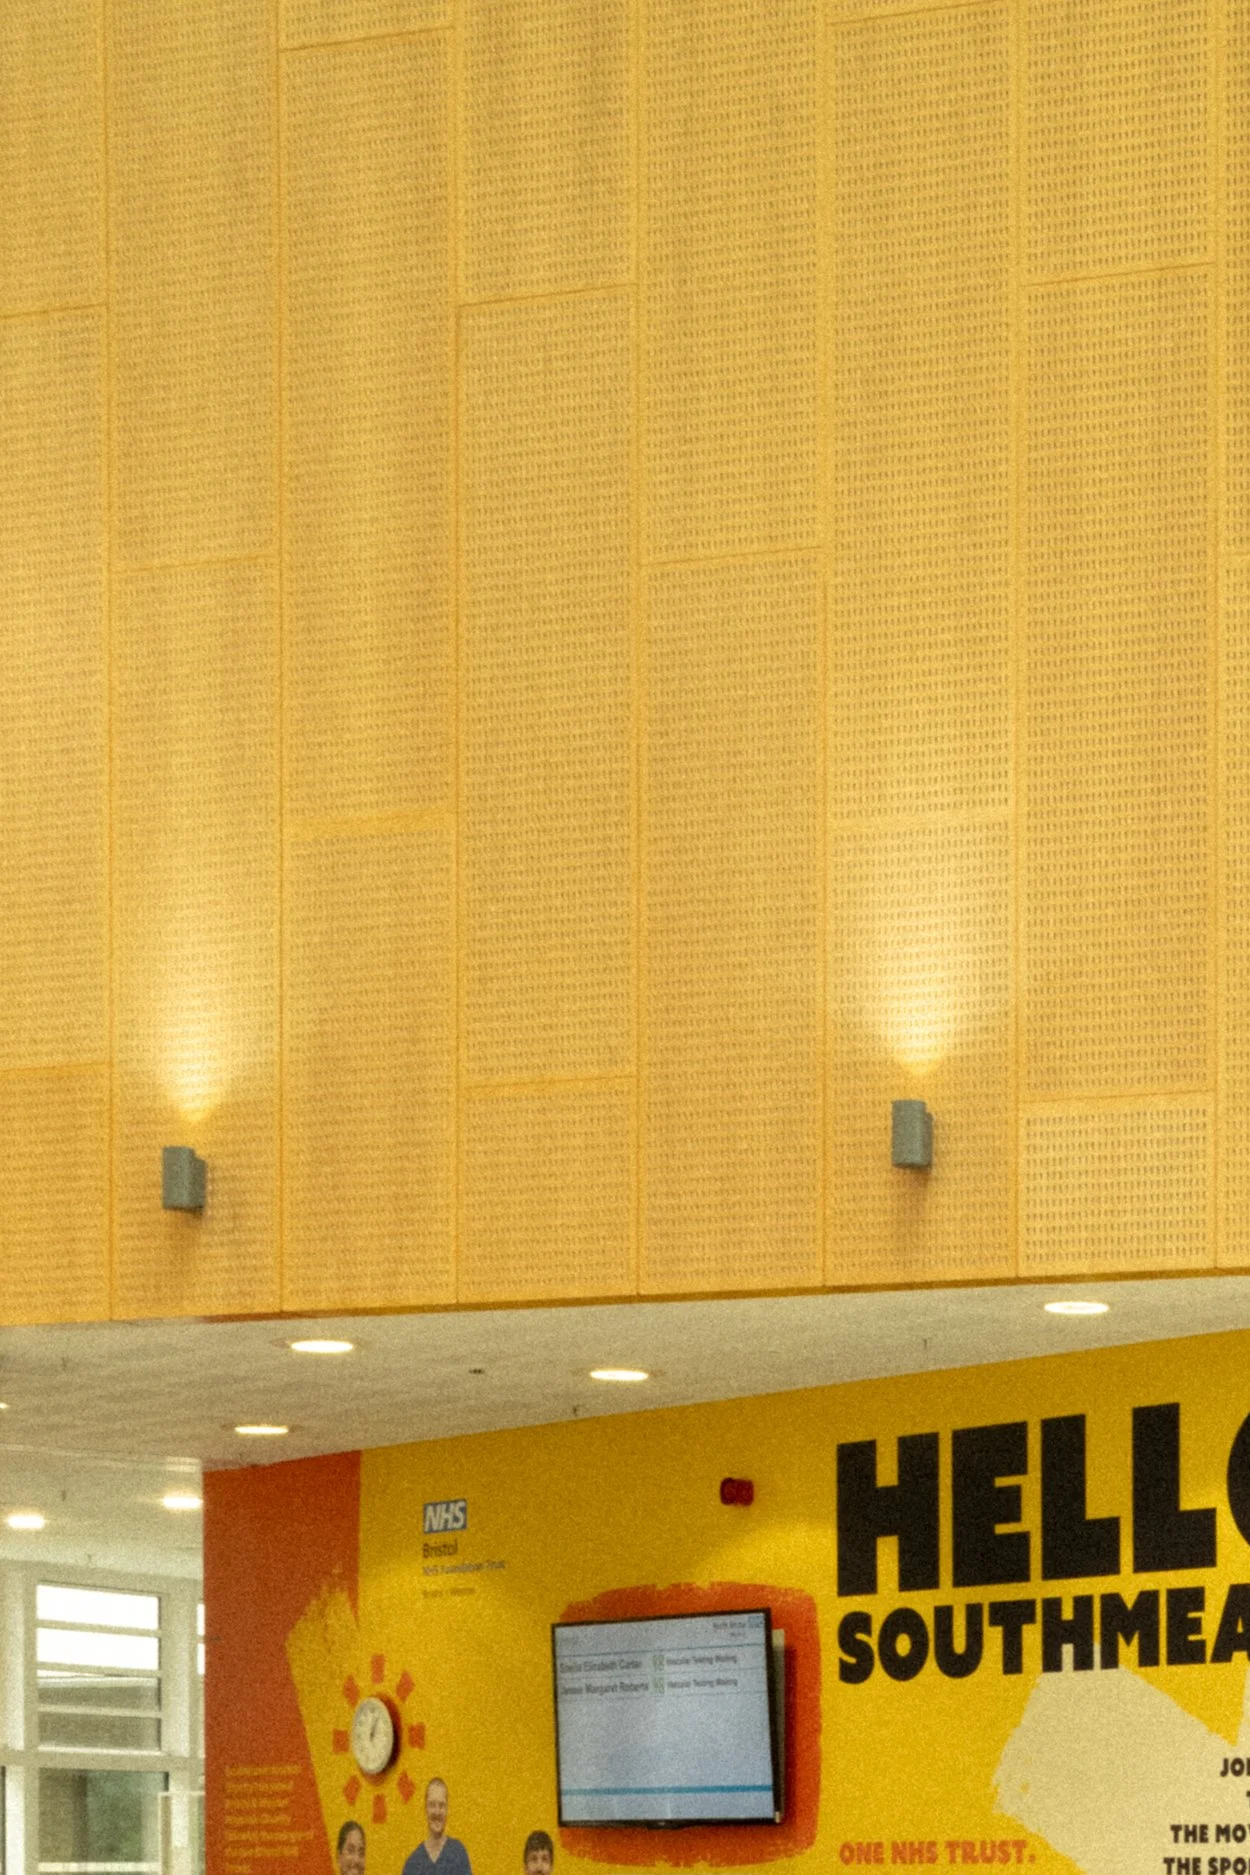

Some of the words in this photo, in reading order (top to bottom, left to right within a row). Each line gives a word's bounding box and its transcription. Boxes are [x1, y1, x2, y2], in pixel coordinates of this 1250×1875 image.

[423, 1500, 467, 1533] NHS
[423, 1538, 459, 1559] Bristol
[1170, 1824, 1209, 1843] THE
[839, 1841, 885, 1865] ONE
[890, 1840, 939, 1865] NHS
[944, 1839, 1036, 1864] TRUST.
[1163, 1857, 1201, 1875] THE
